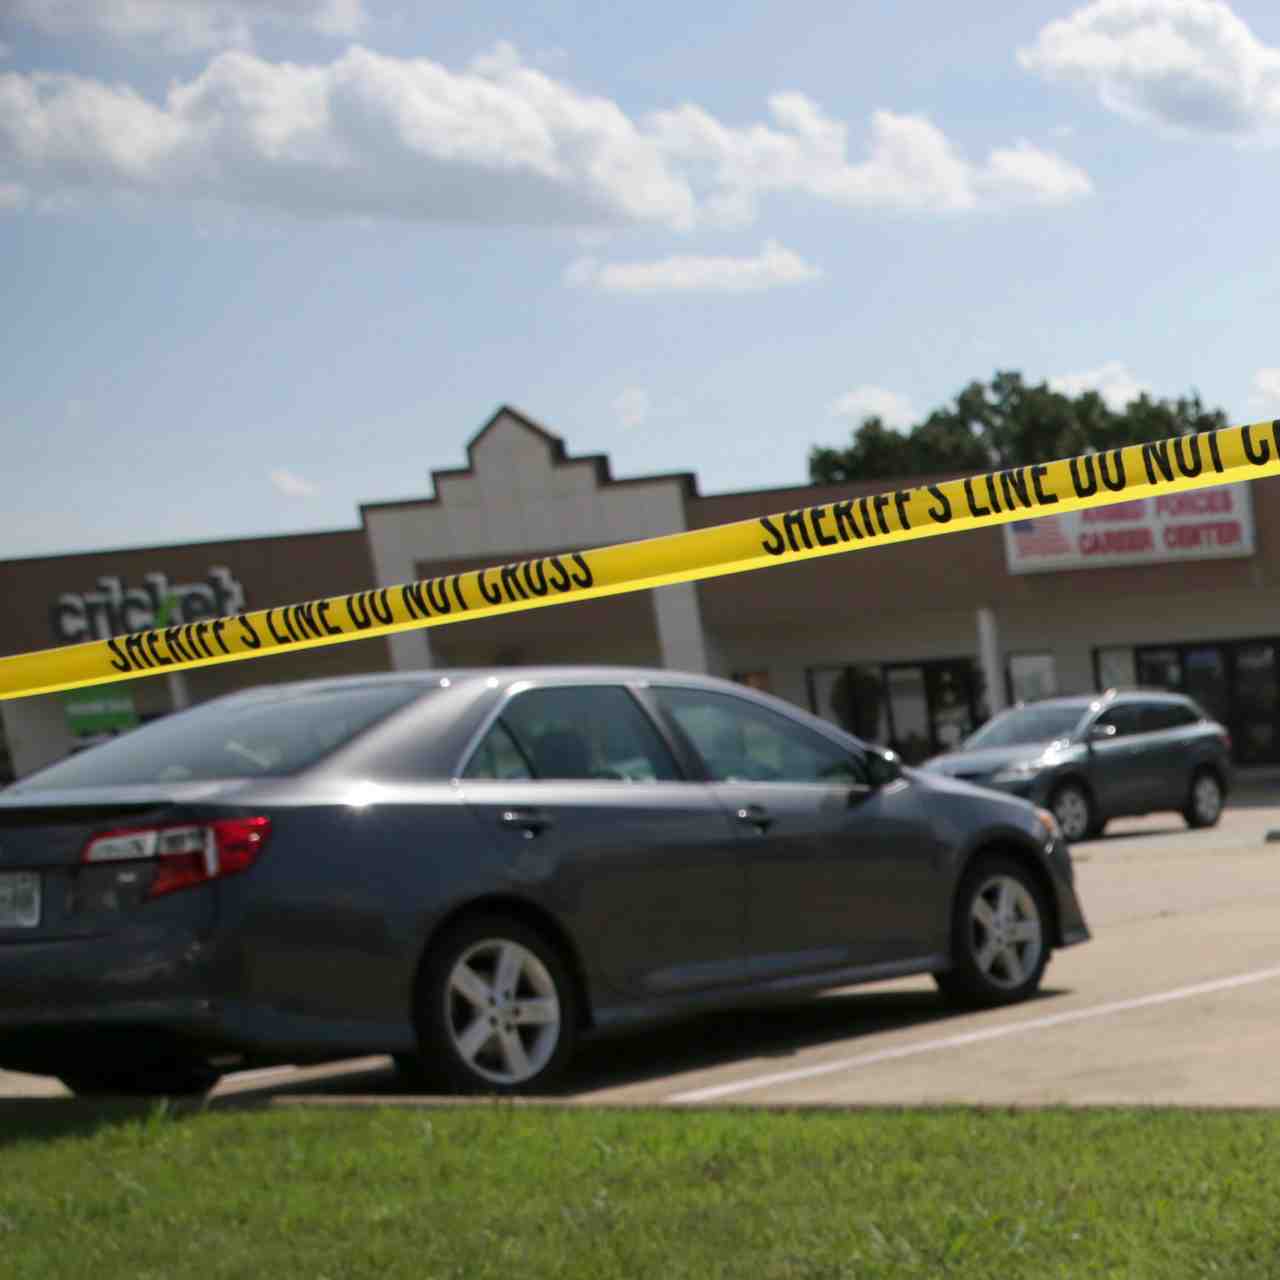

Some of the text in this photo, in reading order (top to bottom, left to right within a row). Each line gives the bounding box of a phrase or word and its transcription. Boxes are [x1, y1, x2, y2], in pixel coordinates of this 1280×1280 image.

[963, 464, 1059, 518] LINE
[1069, 449, 1127, 499] DO
[1141, 431, 1225, 485] NOT
[1078, 521, 1243, 556] CAREER CENTER
[54, 566, 246, 642] cricket
[266, 600, 344, 645] LINE
[346, 588, 395, 629] DO
[401, 575, 469, 620] NOT
[477, 553, 594, 605] CROSS
